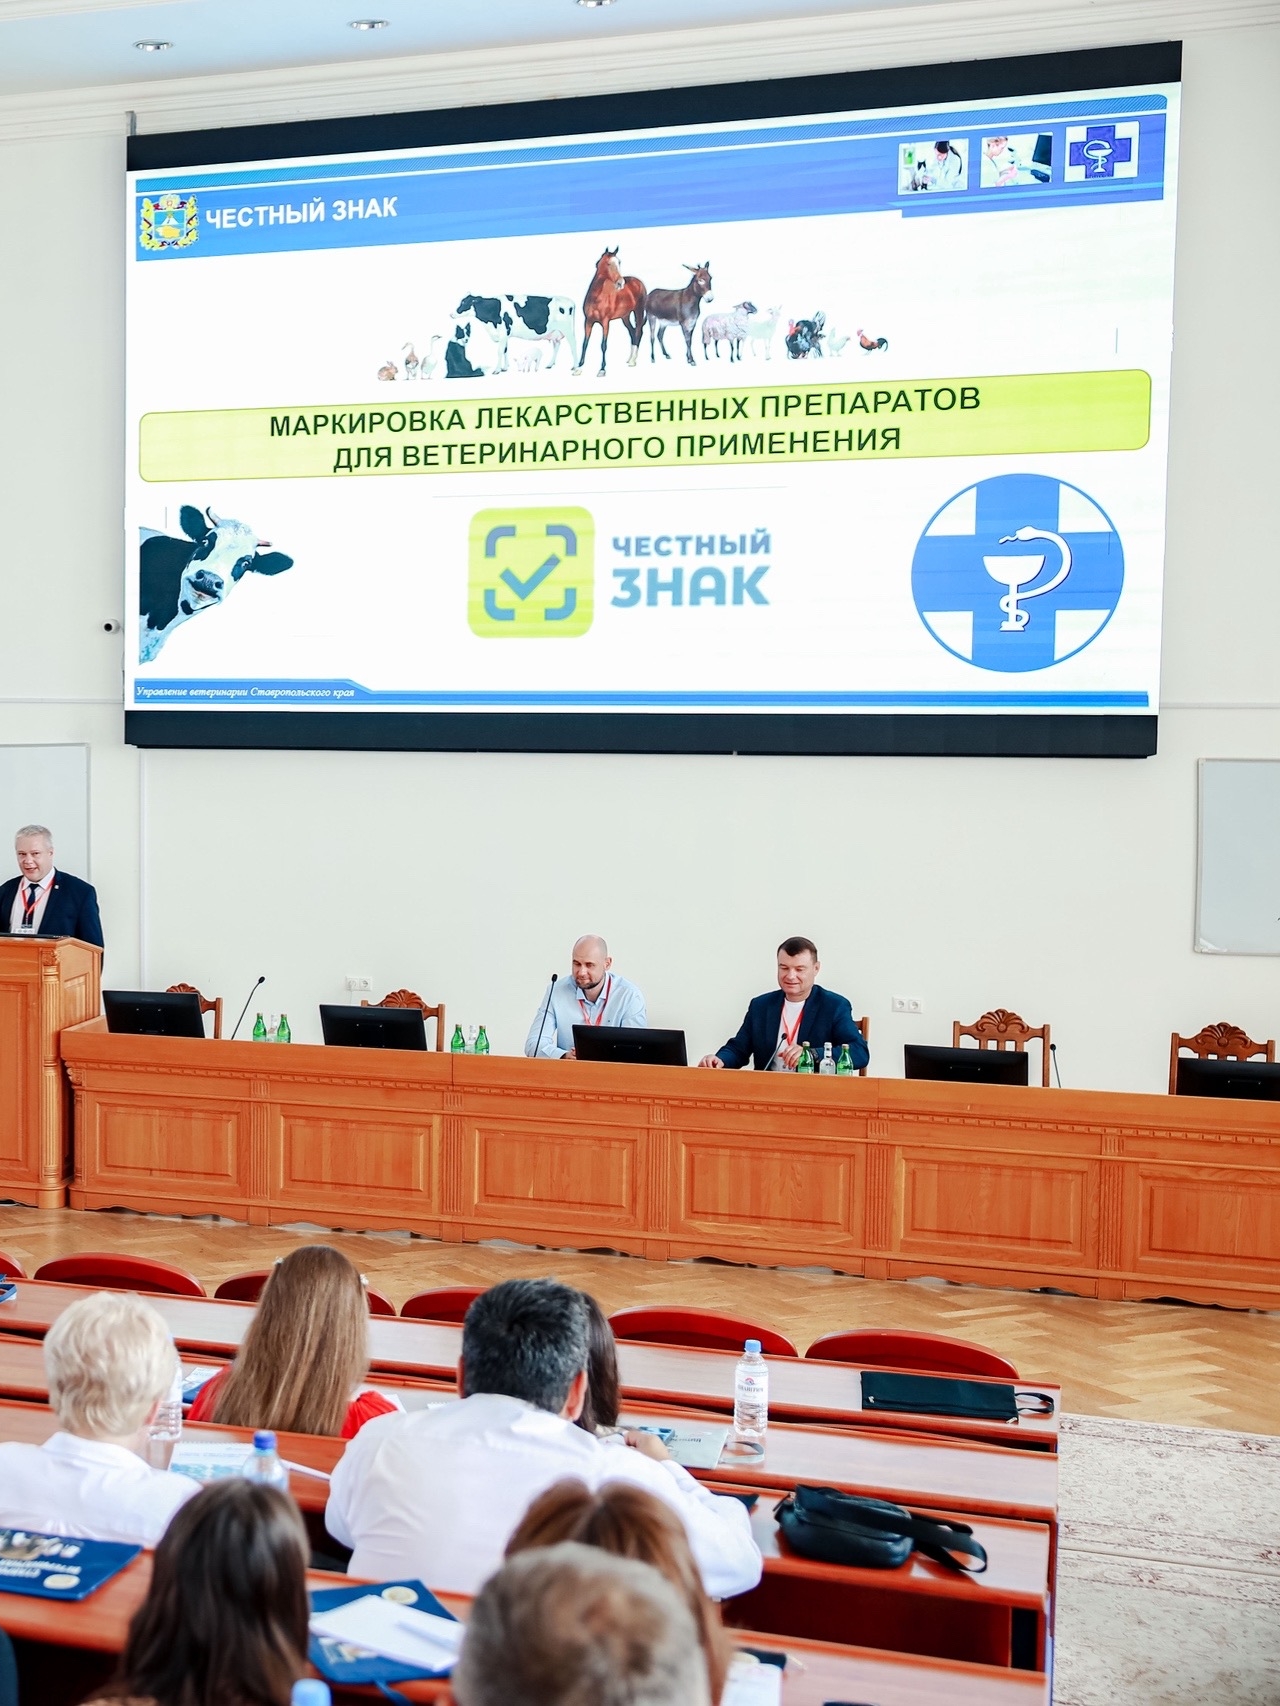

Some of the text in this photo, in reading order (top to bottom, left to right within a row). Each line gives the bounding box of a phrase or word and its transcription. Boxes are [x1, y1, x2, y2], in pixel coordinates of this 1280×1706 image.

[205, 196, 398, 229] ЧЕСТНЫЙ ЗНАК
[270, 386, 981, 437] МАРКИРОВКА ЛЕКАРСТВЕННЫХ ПРЕПАРАТОВ
[333, 428, 901, 473] ДЛЯ ВЕТЕРИНАРНОГО ПРИМЕНЕНИЯ
[612, 528, 771, 557] ЧЕСТНЫЙ
[610, 565, 771, 608] ЗНАК
[136, 686, 355, 699] Управление ветеринарии Ставропольского края
